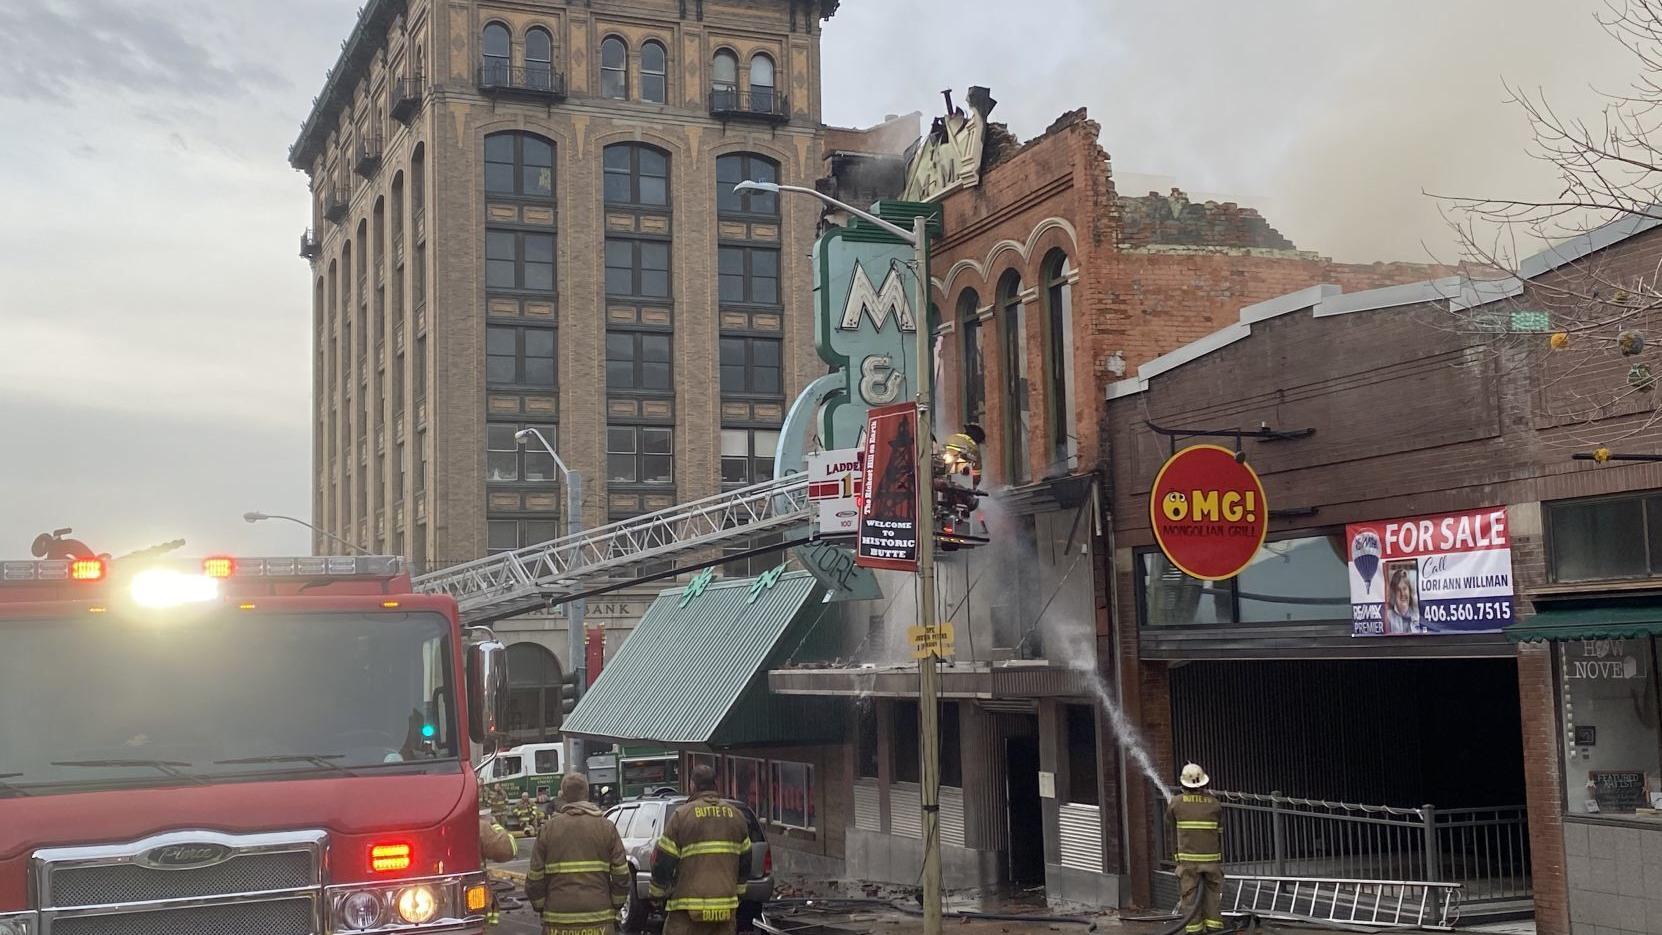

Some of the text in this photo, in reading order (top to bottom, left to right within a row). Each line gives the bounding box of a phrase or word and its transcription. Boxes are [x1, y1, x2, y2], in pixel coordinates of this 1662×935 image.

[840, 258, 917, 333] M
[858, 353, 904, 405] &
[869, 420, 877, 443] Earth
[867, 454, 875, 469] Hill
[841, 472, 853, 499] 1
[865, 469, 873, 499] Richest
[864, 499, 872, 515] The
[866, 519, 912, 529] WELCOME
[1163, 525, 1256, 538] MONGOLIAN GRILL
[882, 529, 895, 537] TO
[1385, 511, 1506, 555] FOR SALE
[862, 536, 916, 548] HISTORIC
[870, 547, 907, 558] BUTTE
[1421, 555, 1448, 579] Call
[1421, 574, 1509, 592] LORI ANN WILLMAN
[1352, 604, 1382, 620] RE/MAX
[1424, 601, 1511, 622] 406.560.7515
[1354, 621, 1384, 634] PREMIER
[695, 806, 721, 818] BUTTE
